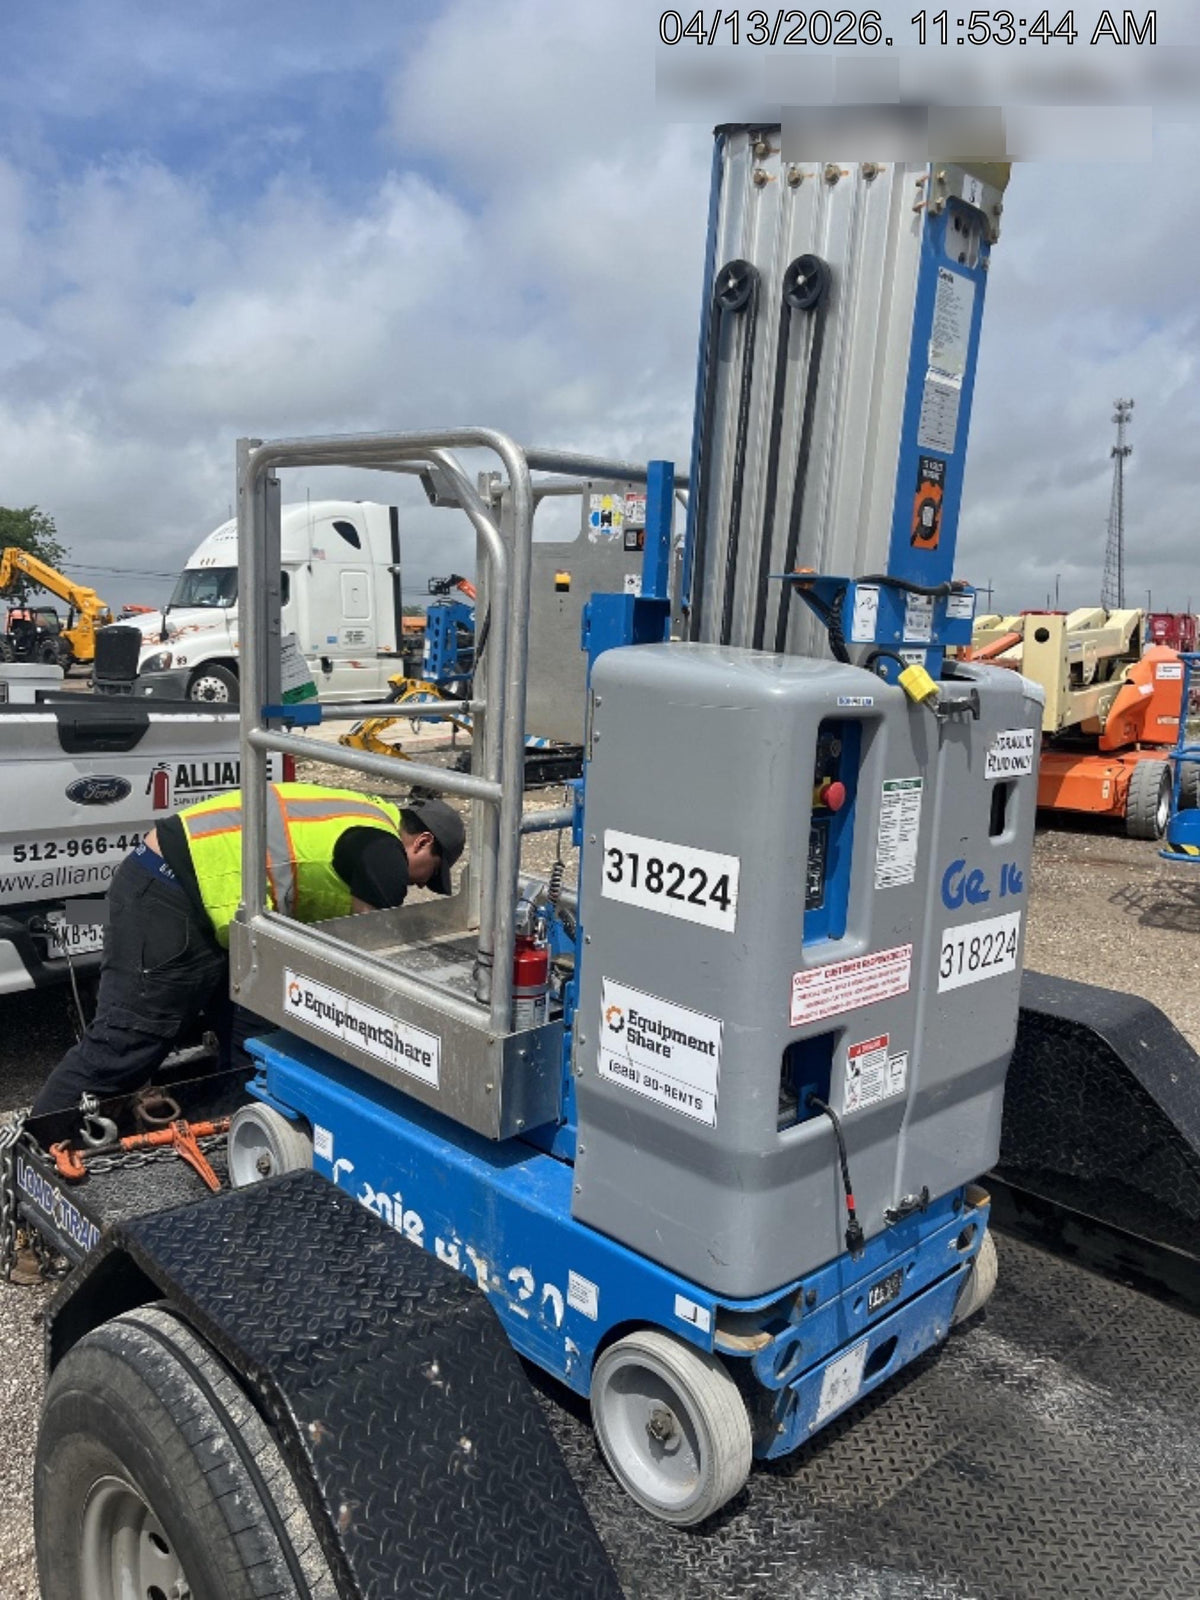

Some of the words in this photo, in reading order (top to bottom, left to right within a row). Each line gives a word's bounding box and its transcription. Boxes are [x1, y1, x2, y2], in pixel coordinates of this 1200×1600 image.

[13, 831, 148, 863] 512-966-44
[606, 847, 731, 912] 318224
[940, 927, 1016, 979] 318224
[627, 1008, 715, 1057] Equipment
[627, 1027, 672, 1059] Share
